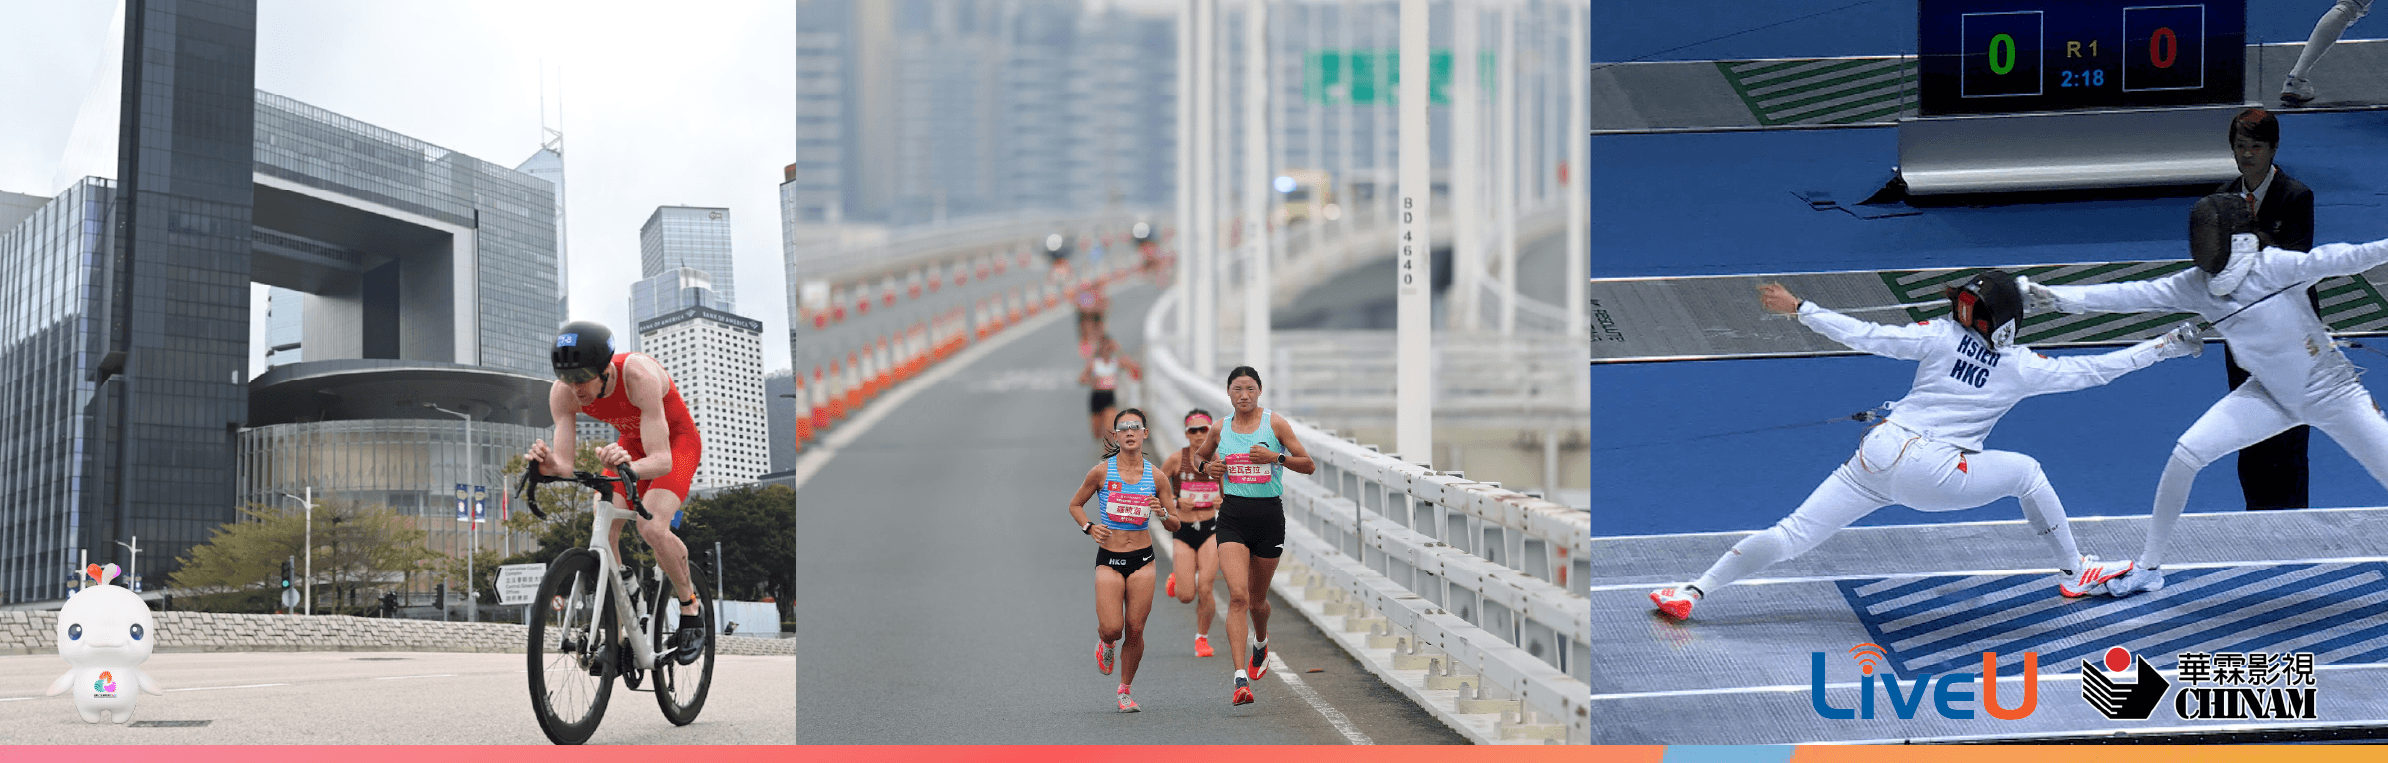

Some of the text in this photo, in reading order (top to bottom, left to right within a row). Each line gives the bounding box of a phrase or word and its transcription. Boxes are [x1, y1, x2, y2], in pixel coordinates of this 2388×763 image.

[1989, 33, 2016, 75] 0
[2066, 40, 2098, 58] R 1
[2150, 26, 2177, 68] 0
[2061, 69, 2104, 87] 2:18
[1403, 197, 1413, 285] BD 4640
[640, 323, 653, 331] BANK
[661, 314, 684, 325] AMERICA
[703, 311, 717, 320] BANK
[725, 317, 748, 327] AMERICA
[1957, 334, 2001, 368] HSIEH
[1950, 358, 1990, 388] HKG
[1229, 465, 1261, 475] 达瓦吉拉
[1108, 557, 1127, 566] HKG
